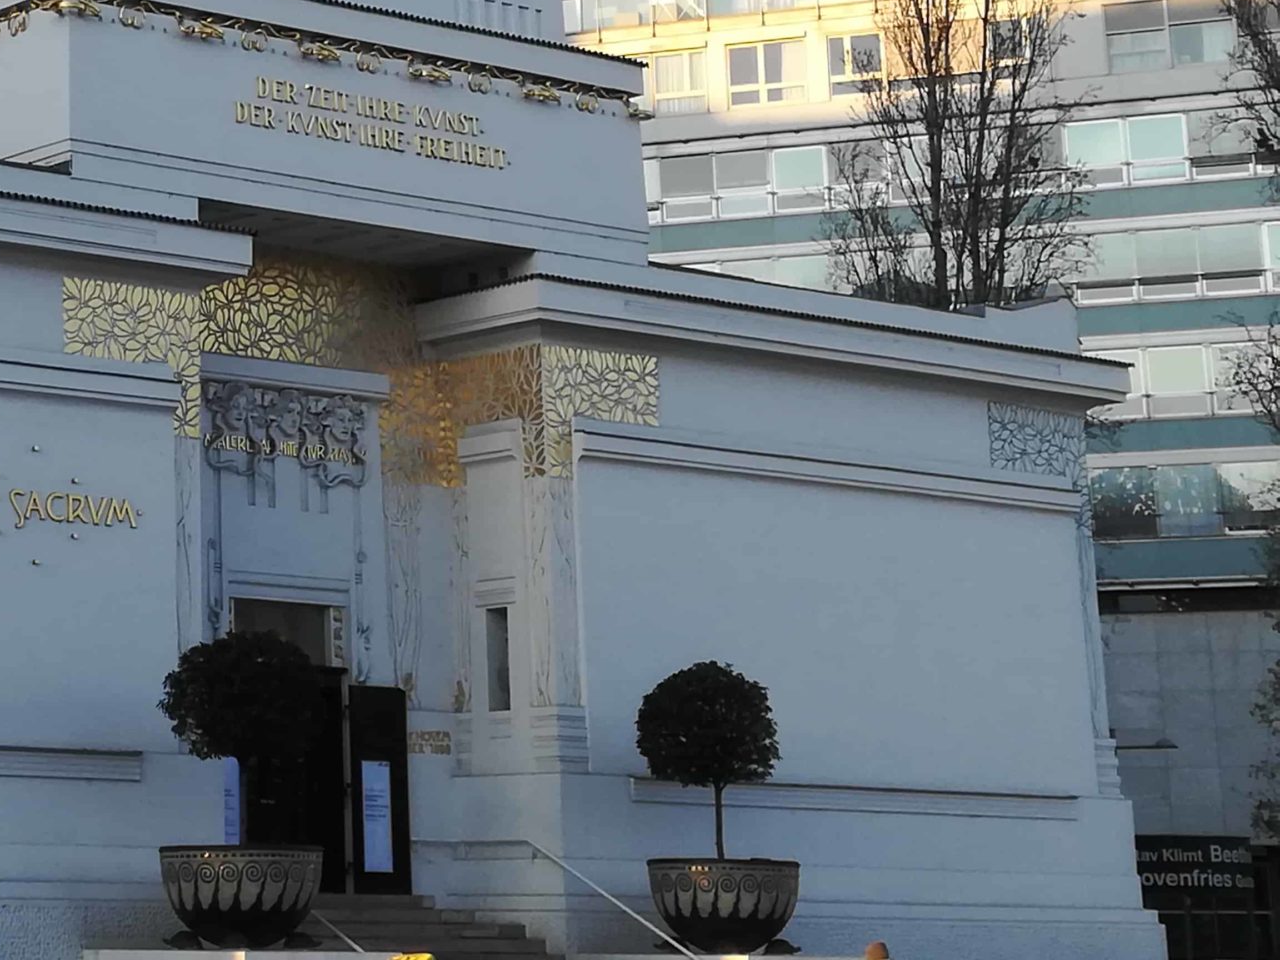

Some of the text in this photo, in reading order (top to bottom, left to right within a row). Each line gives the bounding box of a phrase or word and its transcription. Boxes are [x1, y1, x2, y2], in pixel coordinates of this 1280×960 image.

[256, 75, 298, 105] DER
[304, 83, 350, 115] ZEIT
[356, 94, 407, 125] IHRE
[235, 100, 276, 129] DER
[286, 110, 353, 143] KVNST
[358, 123, 407, 153] IHRE
[8, 485, 138, 530] SACRVM
[1162, 848, 1204, 863] Klimt
[1141, 869, 1233, 888] ovenfries
